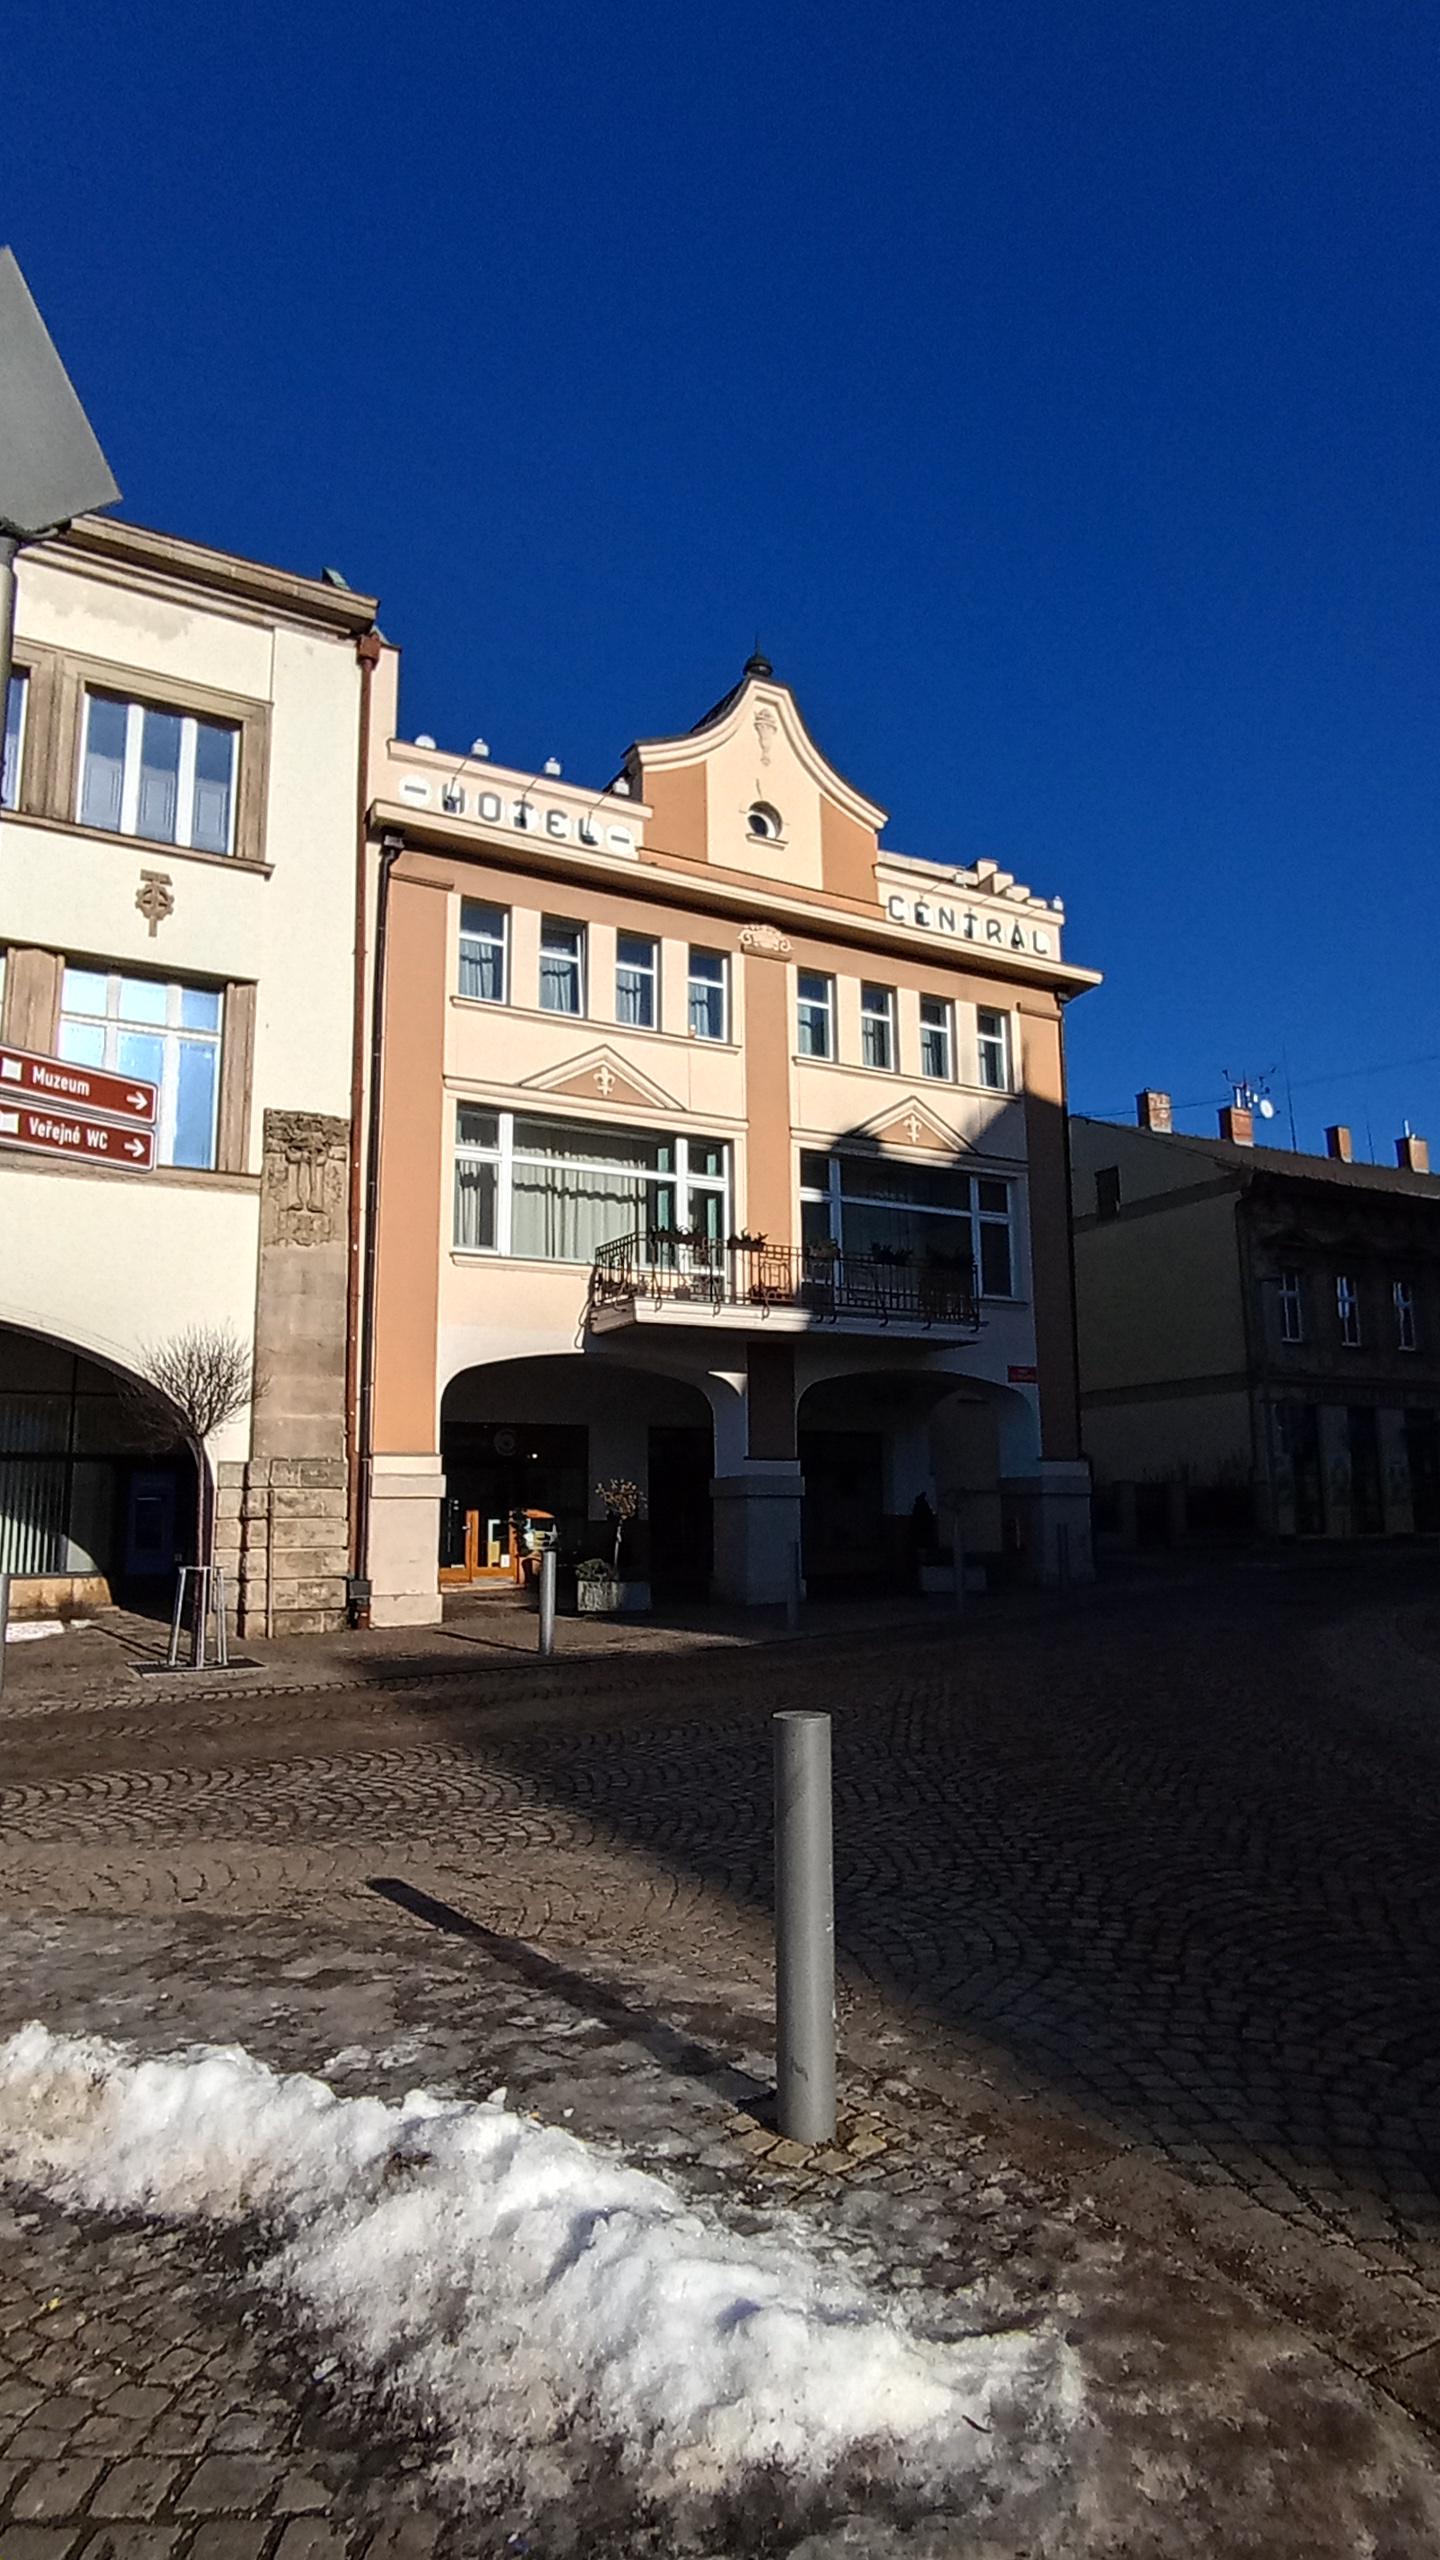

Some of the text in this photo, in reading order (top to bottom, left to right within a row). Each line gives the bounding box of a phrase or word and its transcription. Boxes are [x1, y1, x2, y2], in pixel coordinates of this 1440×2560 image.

[441, 782, 599, 846] HOTEL
[887, 895, 1048, 955] CENTRAL
[32, 1065, 91, 1097] Muzeum
[28, 1116, 109, 1150] Veřejné WC
